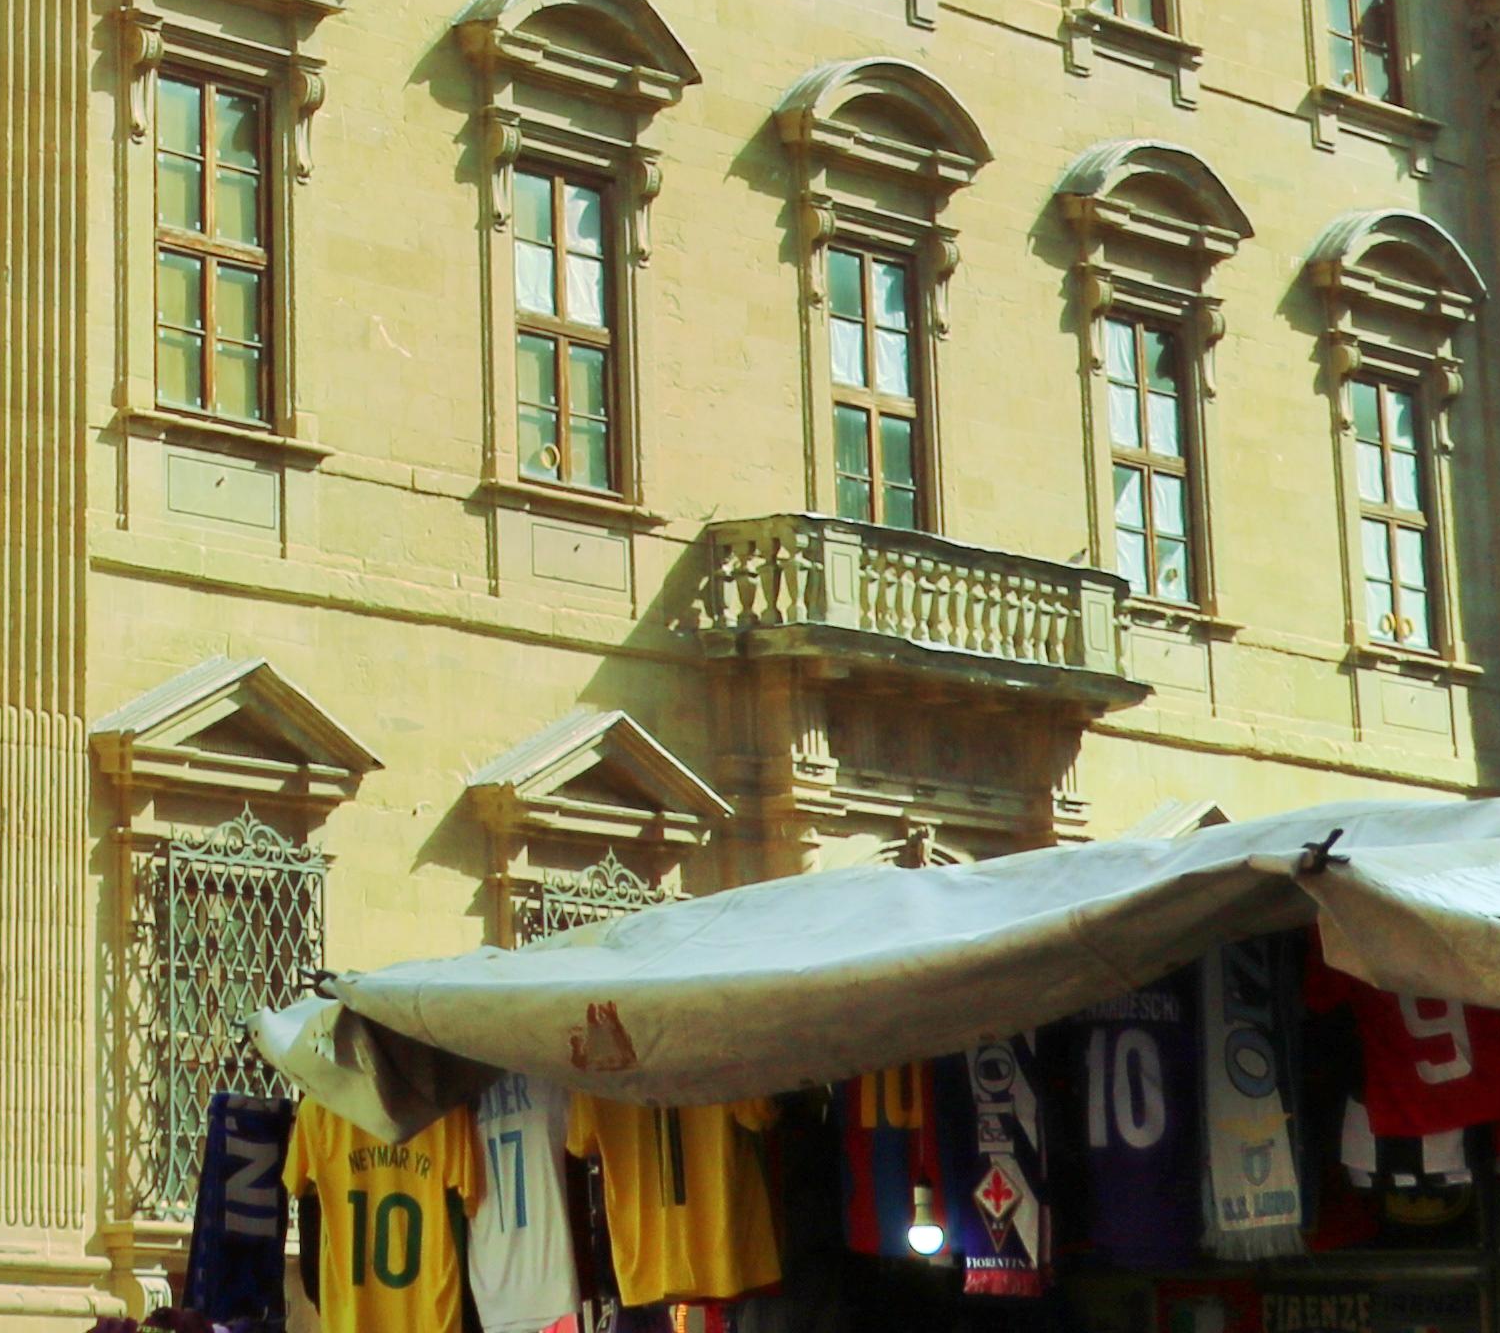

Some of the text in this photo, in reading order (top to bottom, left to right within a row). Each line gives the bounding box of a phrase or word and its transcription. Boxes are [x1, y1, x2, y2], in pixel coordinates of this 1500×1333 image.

[1085, 1029, 1167, 1149] 10
[348, 1144, 410, 1175] NEYMAR
[347, 1189, 423, 1289] 10
